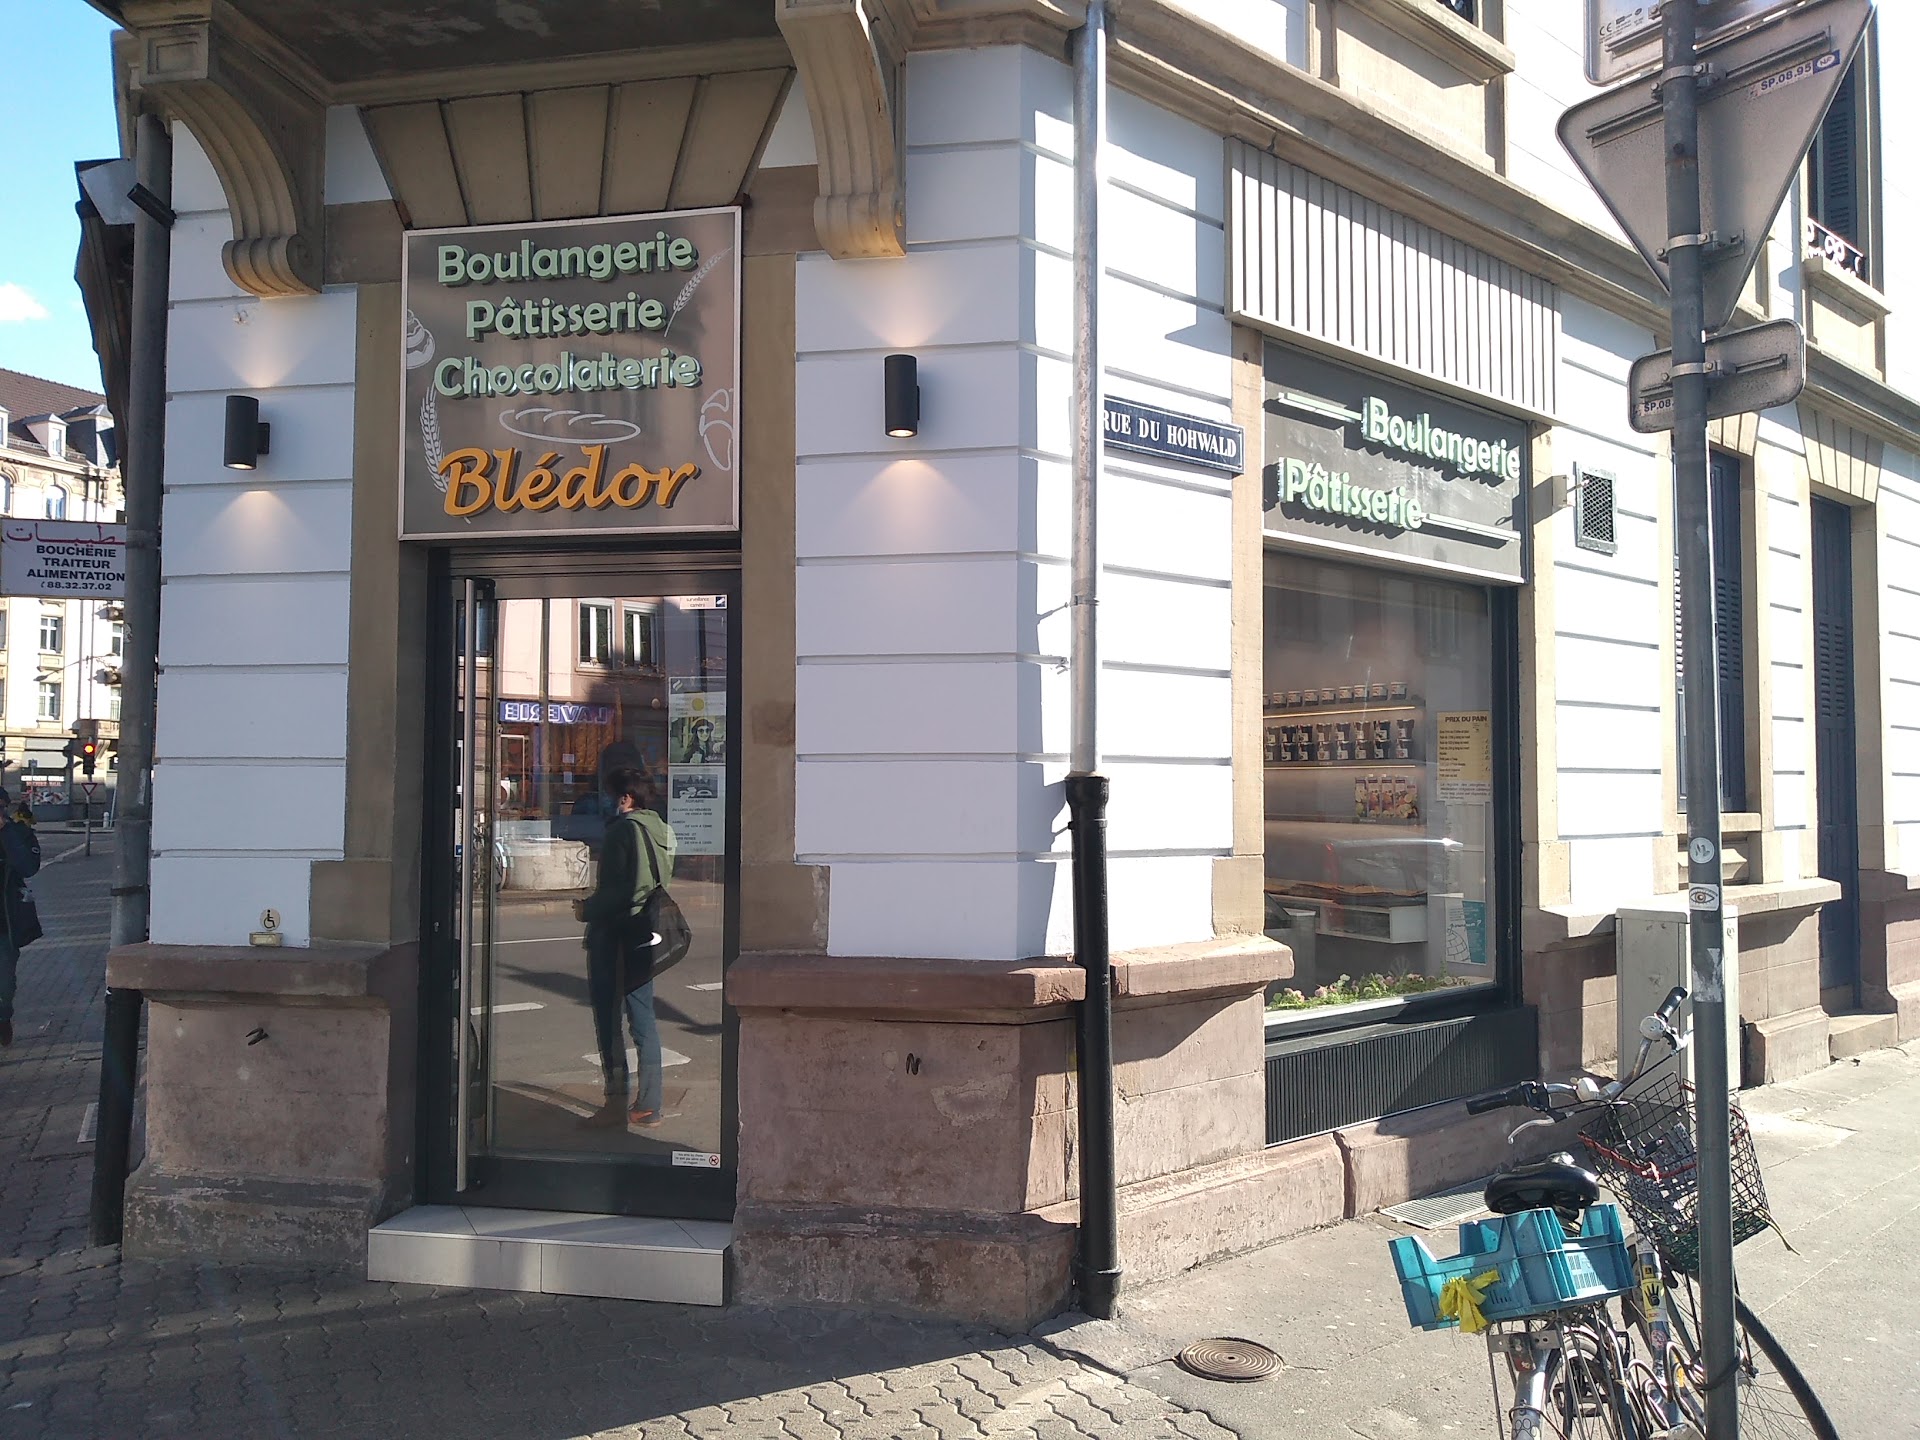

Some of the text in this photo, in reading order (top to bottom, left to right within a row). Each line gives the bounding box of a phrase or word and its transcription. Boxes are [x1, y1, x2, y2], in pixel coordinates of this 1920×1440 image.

[1761, 63, 1812, 91] SP.08.95
[438, 231, 699, 287] Boulangerie
[466, 292, 667, 341] Pâtisserie
[434, 347, 704, 399] Chocolaterie
[1644, 399, 1674, 412] SP.08.
[1103, 410, 1237, 459] RUE DU HOHWALD
[1361, 396, 1521, 480] Boulangerie
[438, 444, 701, 517] Blédor
[1278, 456, 1422, 530] Pâtisserie
[27, 569, 126, 582] ALIMENTATION
[36, 545, 117, 558] BOUCHERIE
[42, 557, 111, 569] TRAITEUR
[46, 581, 112, 591] 88.32.37.02
